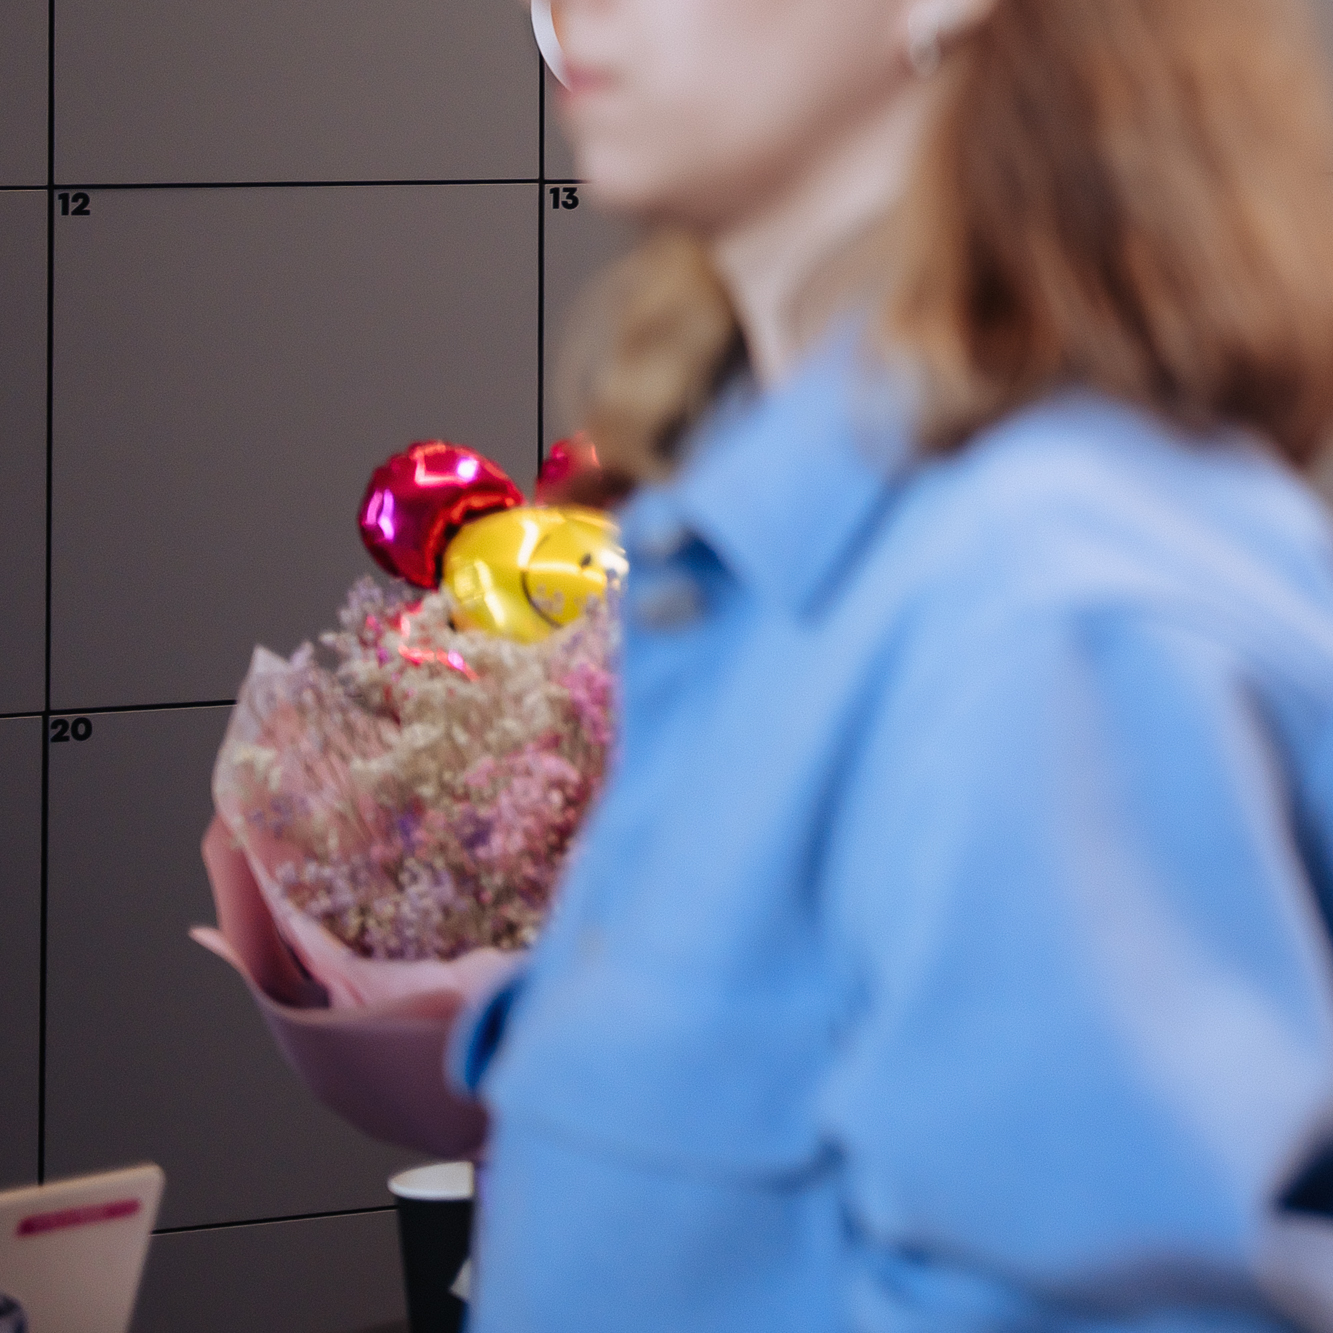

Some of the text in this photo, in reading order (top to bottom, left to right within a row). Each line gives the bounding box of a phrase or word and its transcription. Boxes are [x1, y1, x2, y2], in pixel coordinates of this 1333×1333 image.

[57, 192, 91, 217] 12
[549, 186, 580, 211] 13
[50, 716, 93, 743] 20
